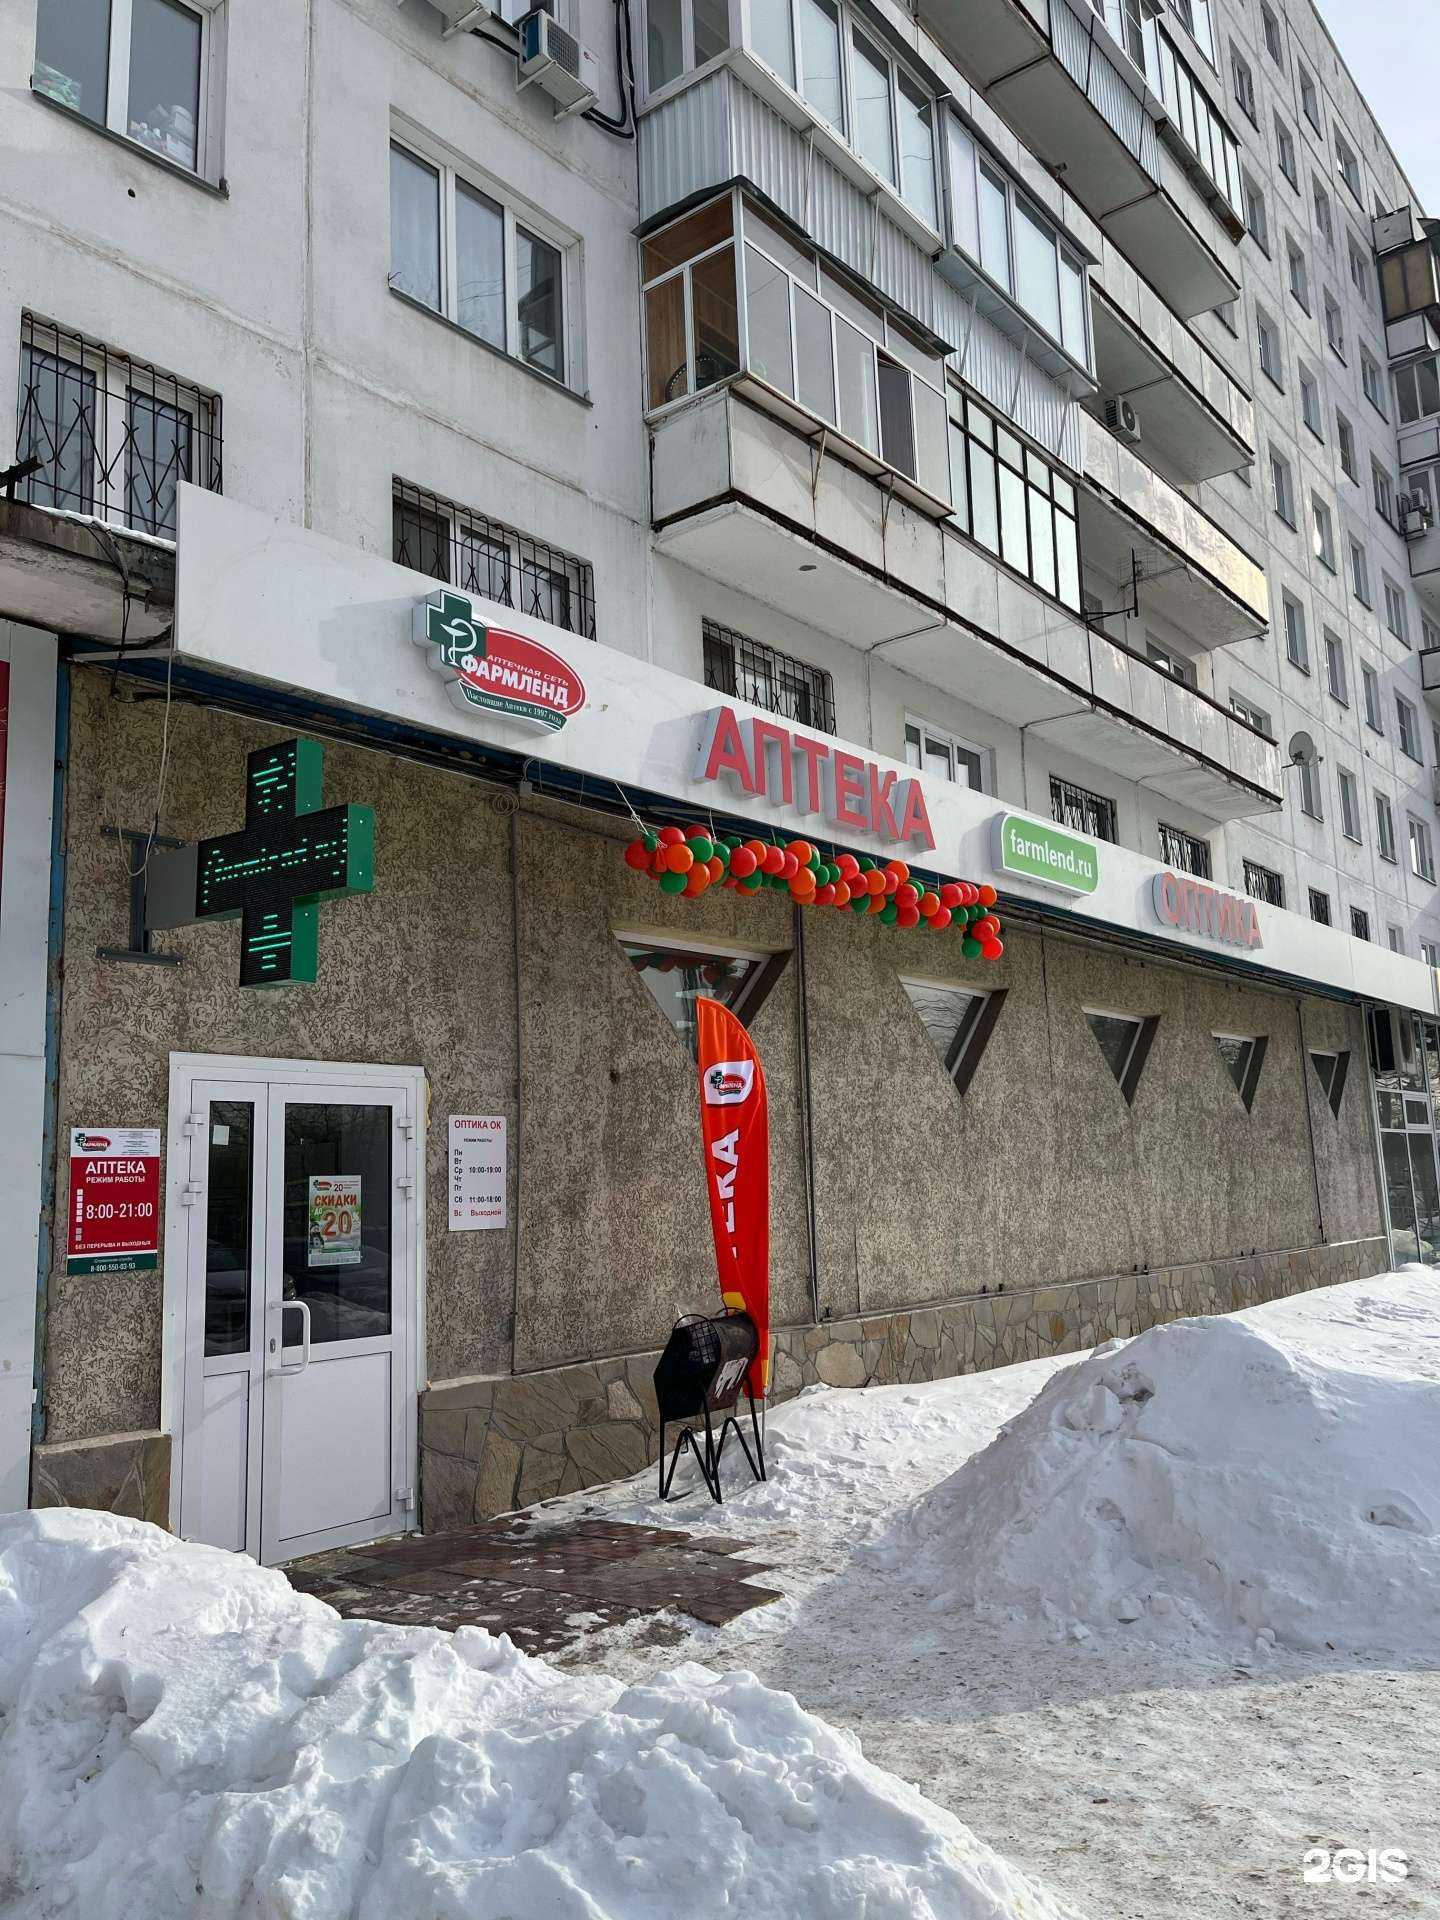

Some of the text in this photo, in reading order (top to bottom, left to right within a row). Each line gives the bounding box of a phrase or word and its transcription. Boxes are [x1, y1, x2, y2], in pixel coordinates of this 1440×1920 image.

[487, 654, 569, 687] АПТЕЧНАЯ СЕТЬ
[460, 654, 568, 709] ФАРМЛЕНД
[533, 707, 547, 718] 1997
[704, 705, 936, 851] АПТЕКА
[1010, 828, 1094, 879] farmlend.ru
[1159, 871, 1262, 947] ОПТИКА
[454, 1119, 502, 1130] ОПТИКА ОК
[85, 1160, 146, 1174] АПТЕКА
[454, 1166, 463, 1174] Ср
[314, 1194, 357, 1208] СКИДКИ
[86, 1202, 153, 1219] 8:00-21:00
[470, 1209, 502, 1217] Выходной
